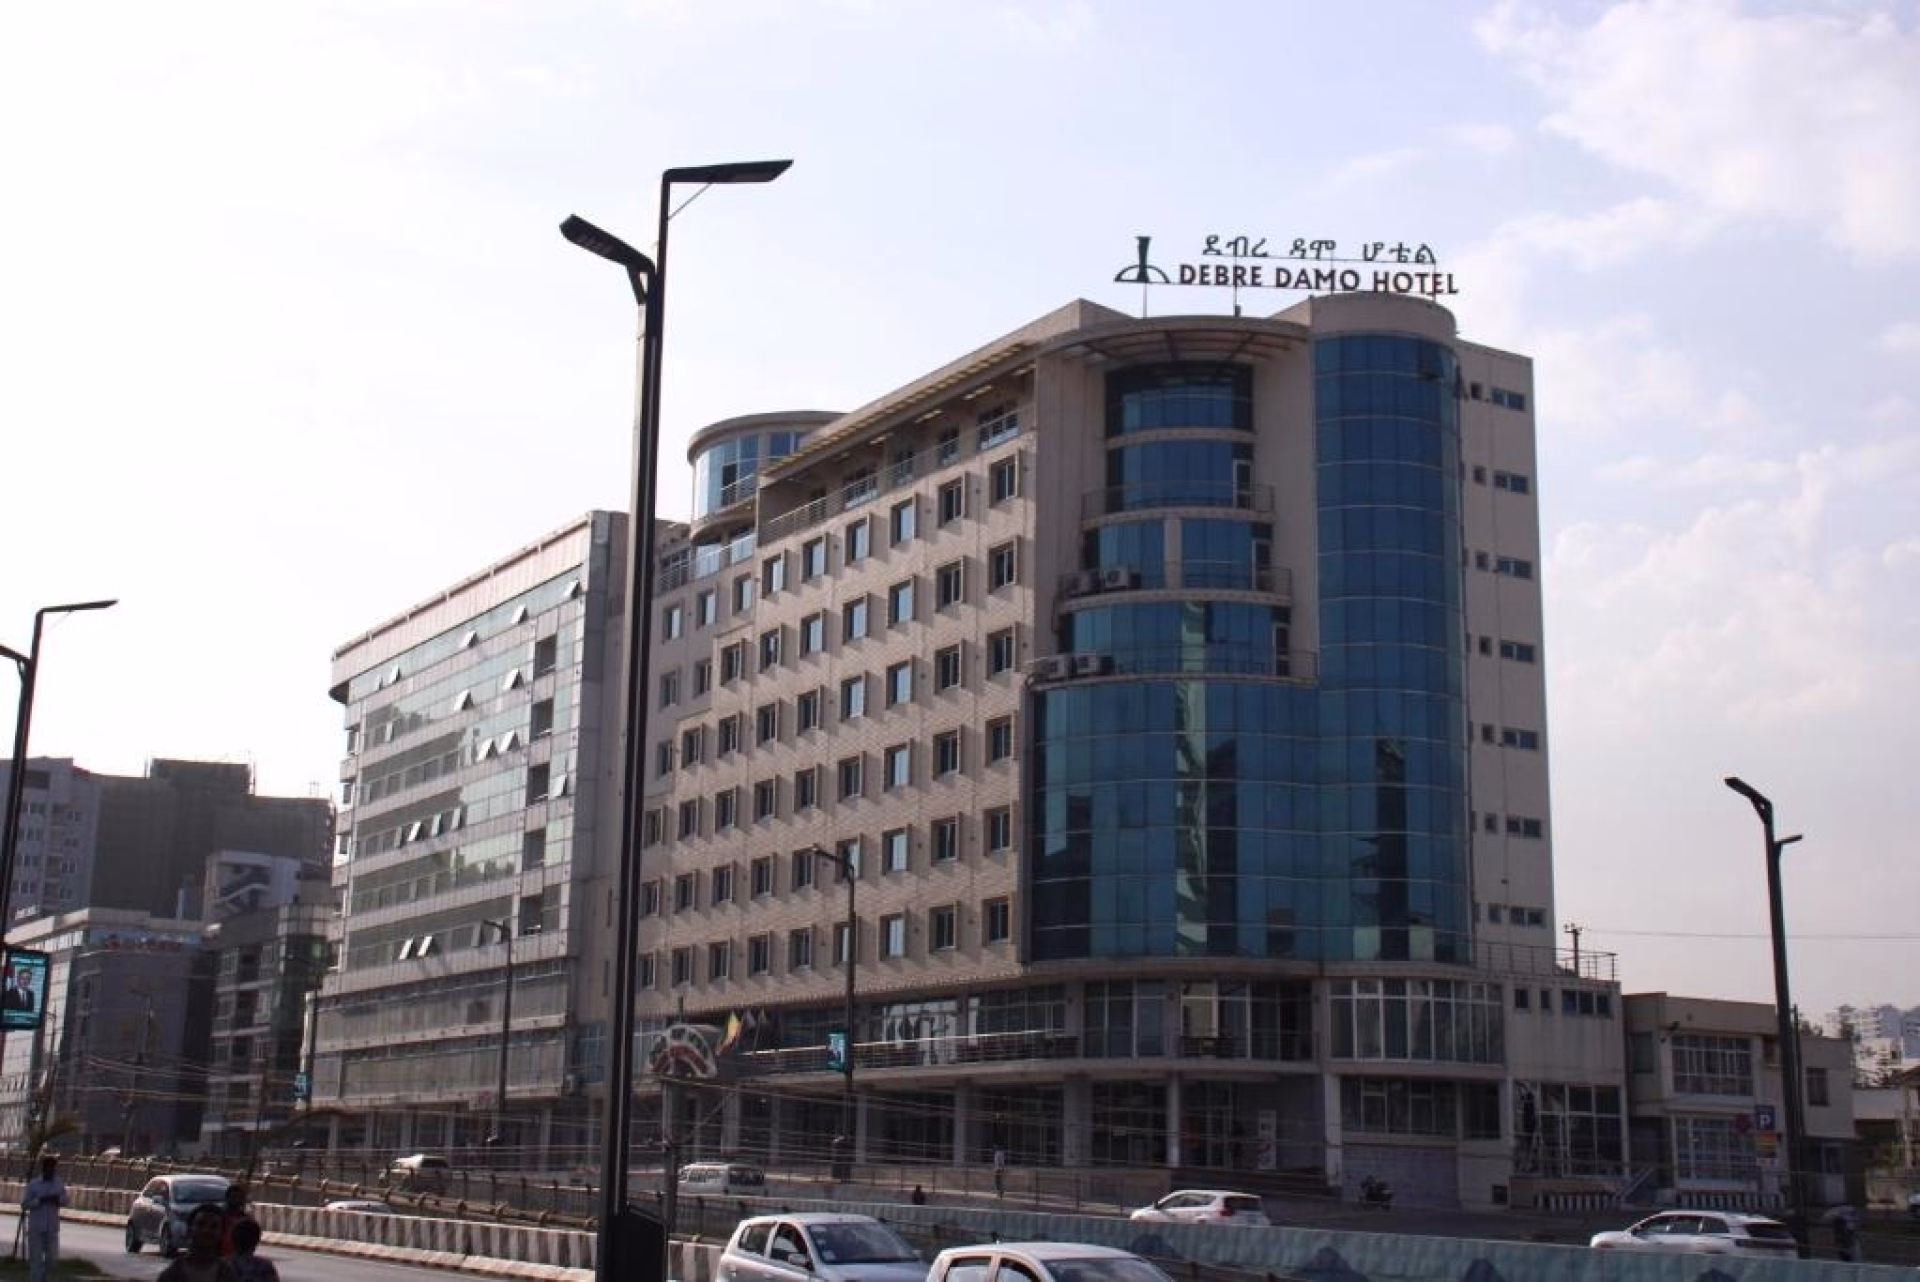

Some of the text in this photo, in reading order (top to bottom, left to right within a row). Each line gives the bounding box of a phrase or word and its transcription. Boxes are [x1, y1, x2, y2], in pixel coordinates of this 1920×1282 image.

[1202, 234, 1436, 264] ደብረ ዳሞ ሆቴል
[1179, 264, 1459, 294] DEBRE DAMO HOTEL
[1759, 1114, 1771, 1130] P
